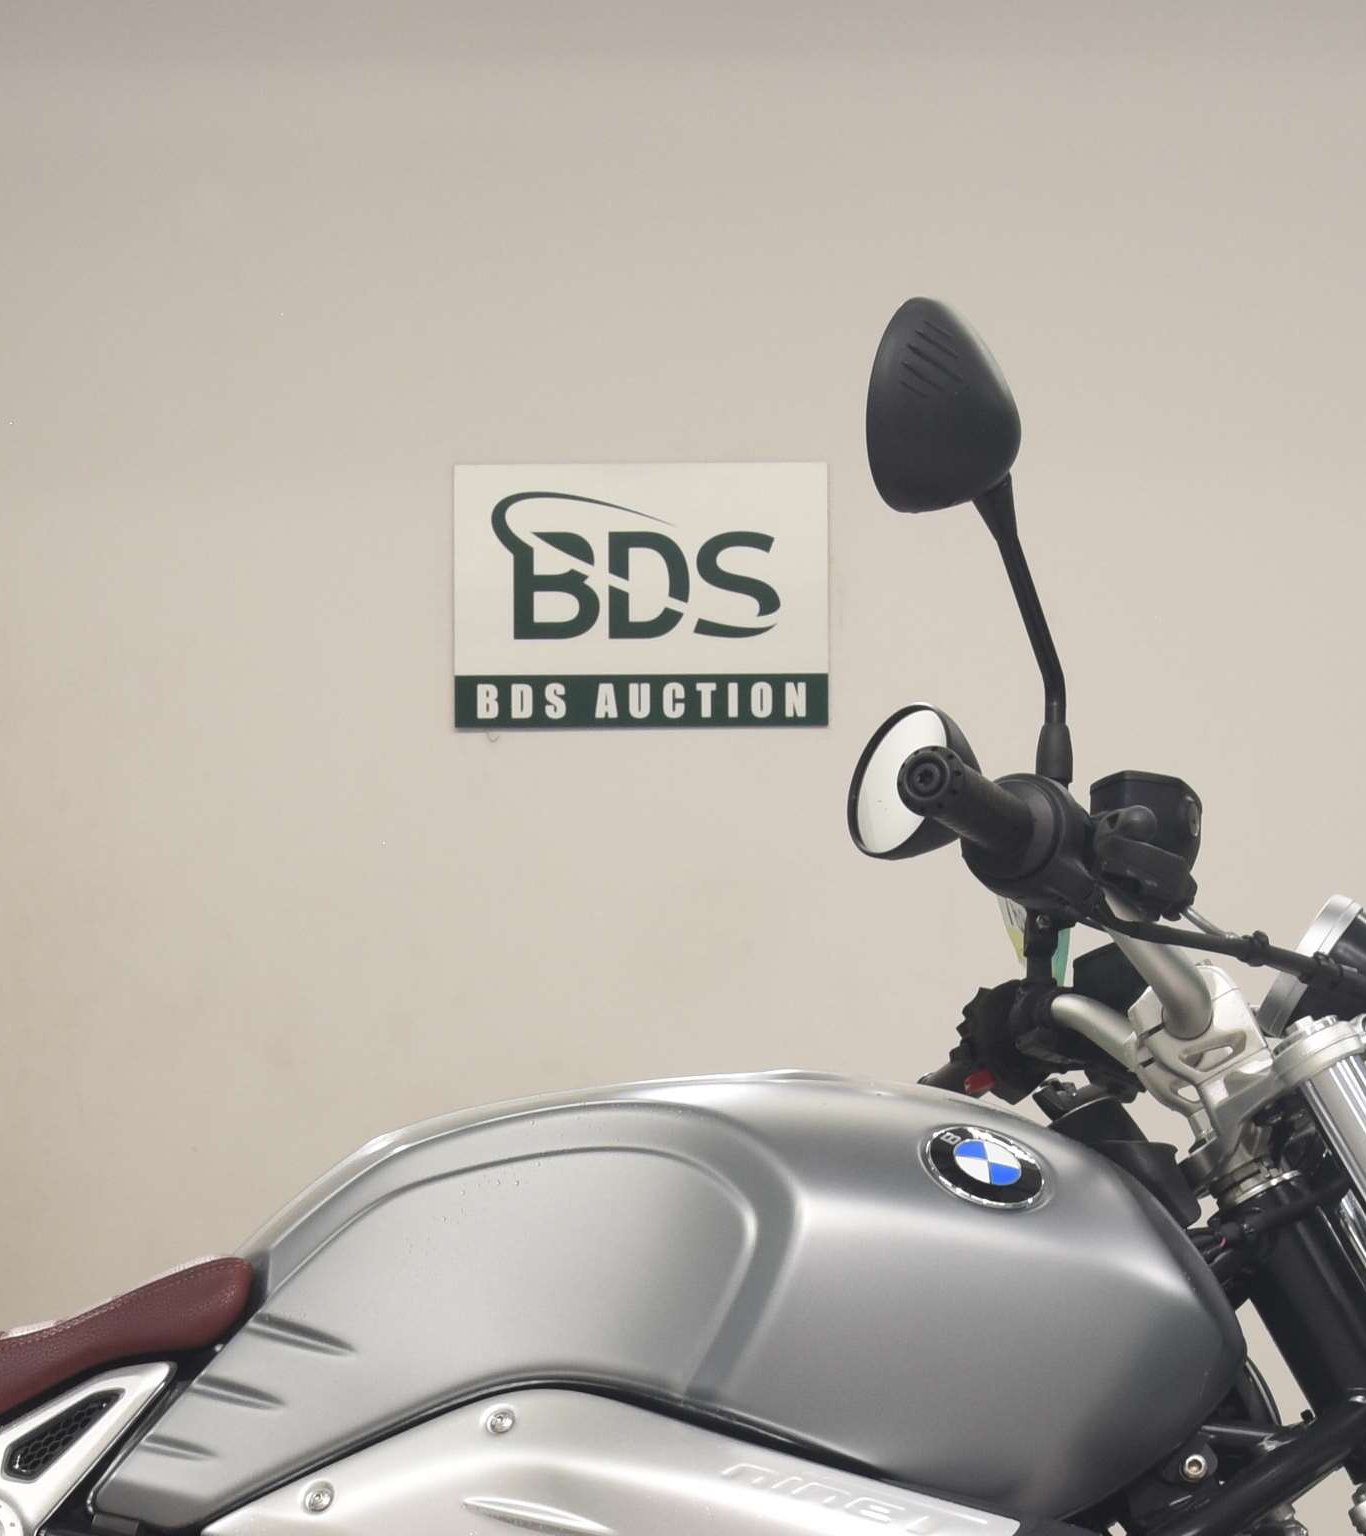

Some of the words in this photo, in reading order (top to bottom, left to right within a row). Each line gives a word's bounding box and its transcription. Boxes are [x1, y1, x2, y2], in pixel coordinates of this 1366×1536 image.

[491, 491, 781, 640] BDS
[476, 683, 567, 719] BDS
[595, 681, 807, 719] AUCTION
